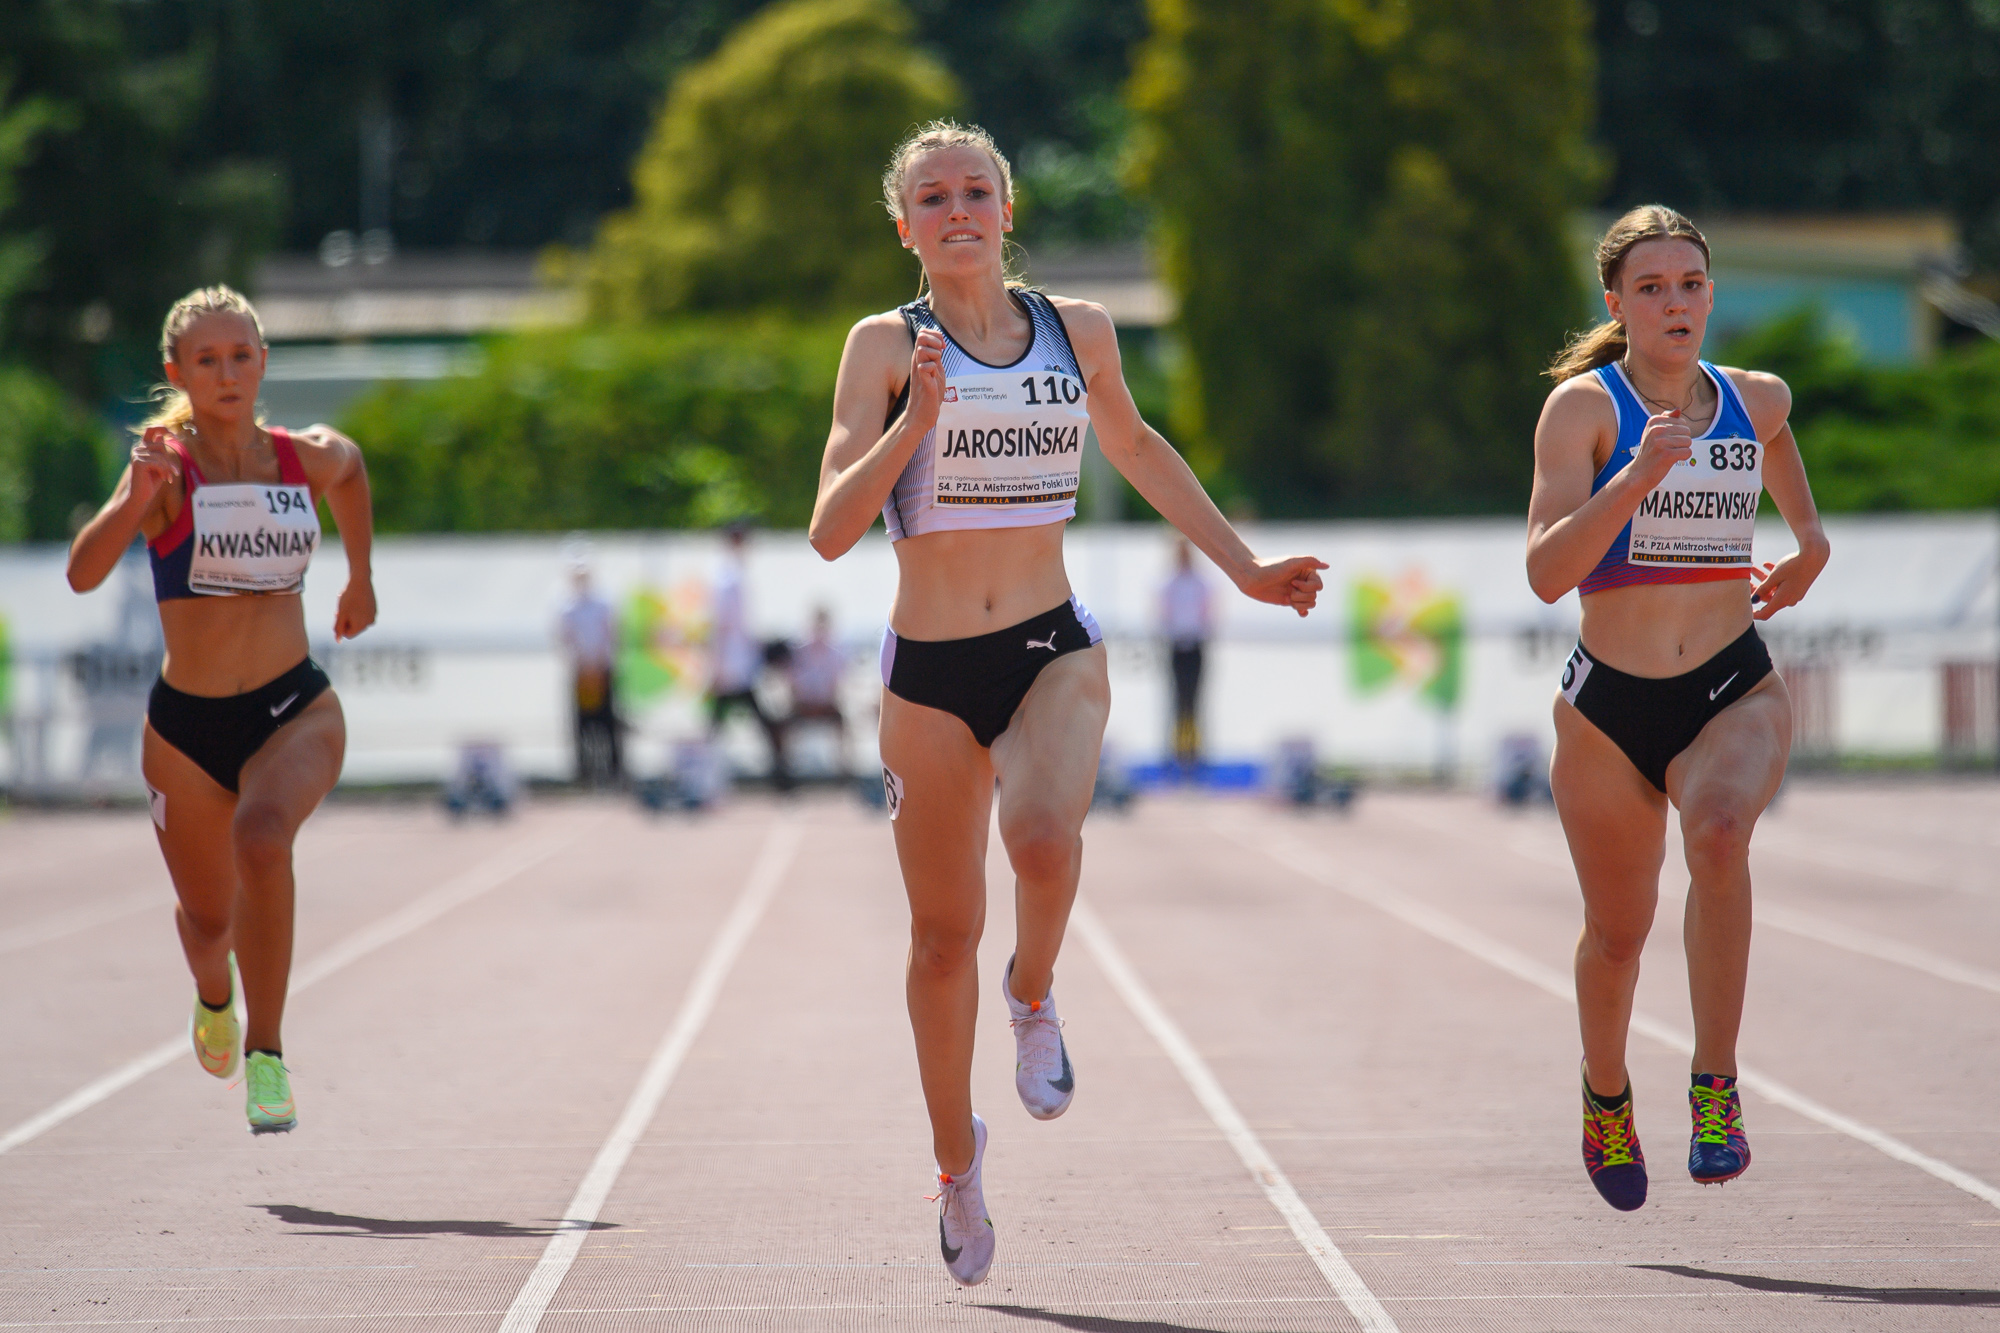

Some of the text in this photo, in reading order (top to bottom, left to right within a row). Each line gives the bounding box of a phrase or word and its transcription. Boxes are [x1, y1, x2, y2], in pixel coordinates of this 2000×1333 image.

[1021, 376, 1081, 406] 110
[942, 421, 1078, 459] JAROSIŃSKA
[1709, 443, 1757, 471] 833
[938, 476, 1078, 493] 54. PZLA Mistrzostwa Polski U18
[266, 491, 307, 514] 194
[1639, 490, 1757, 520] MARSZEWSKA
[1633, 540, 1648, 549] 54.
[1651, 541, 1670, 551] PZLA
[1673, 542, 1724, 552] Mistrzostwa
[1562, 649, 1584, 691] 5
[883, 767, 898, 810] 6
